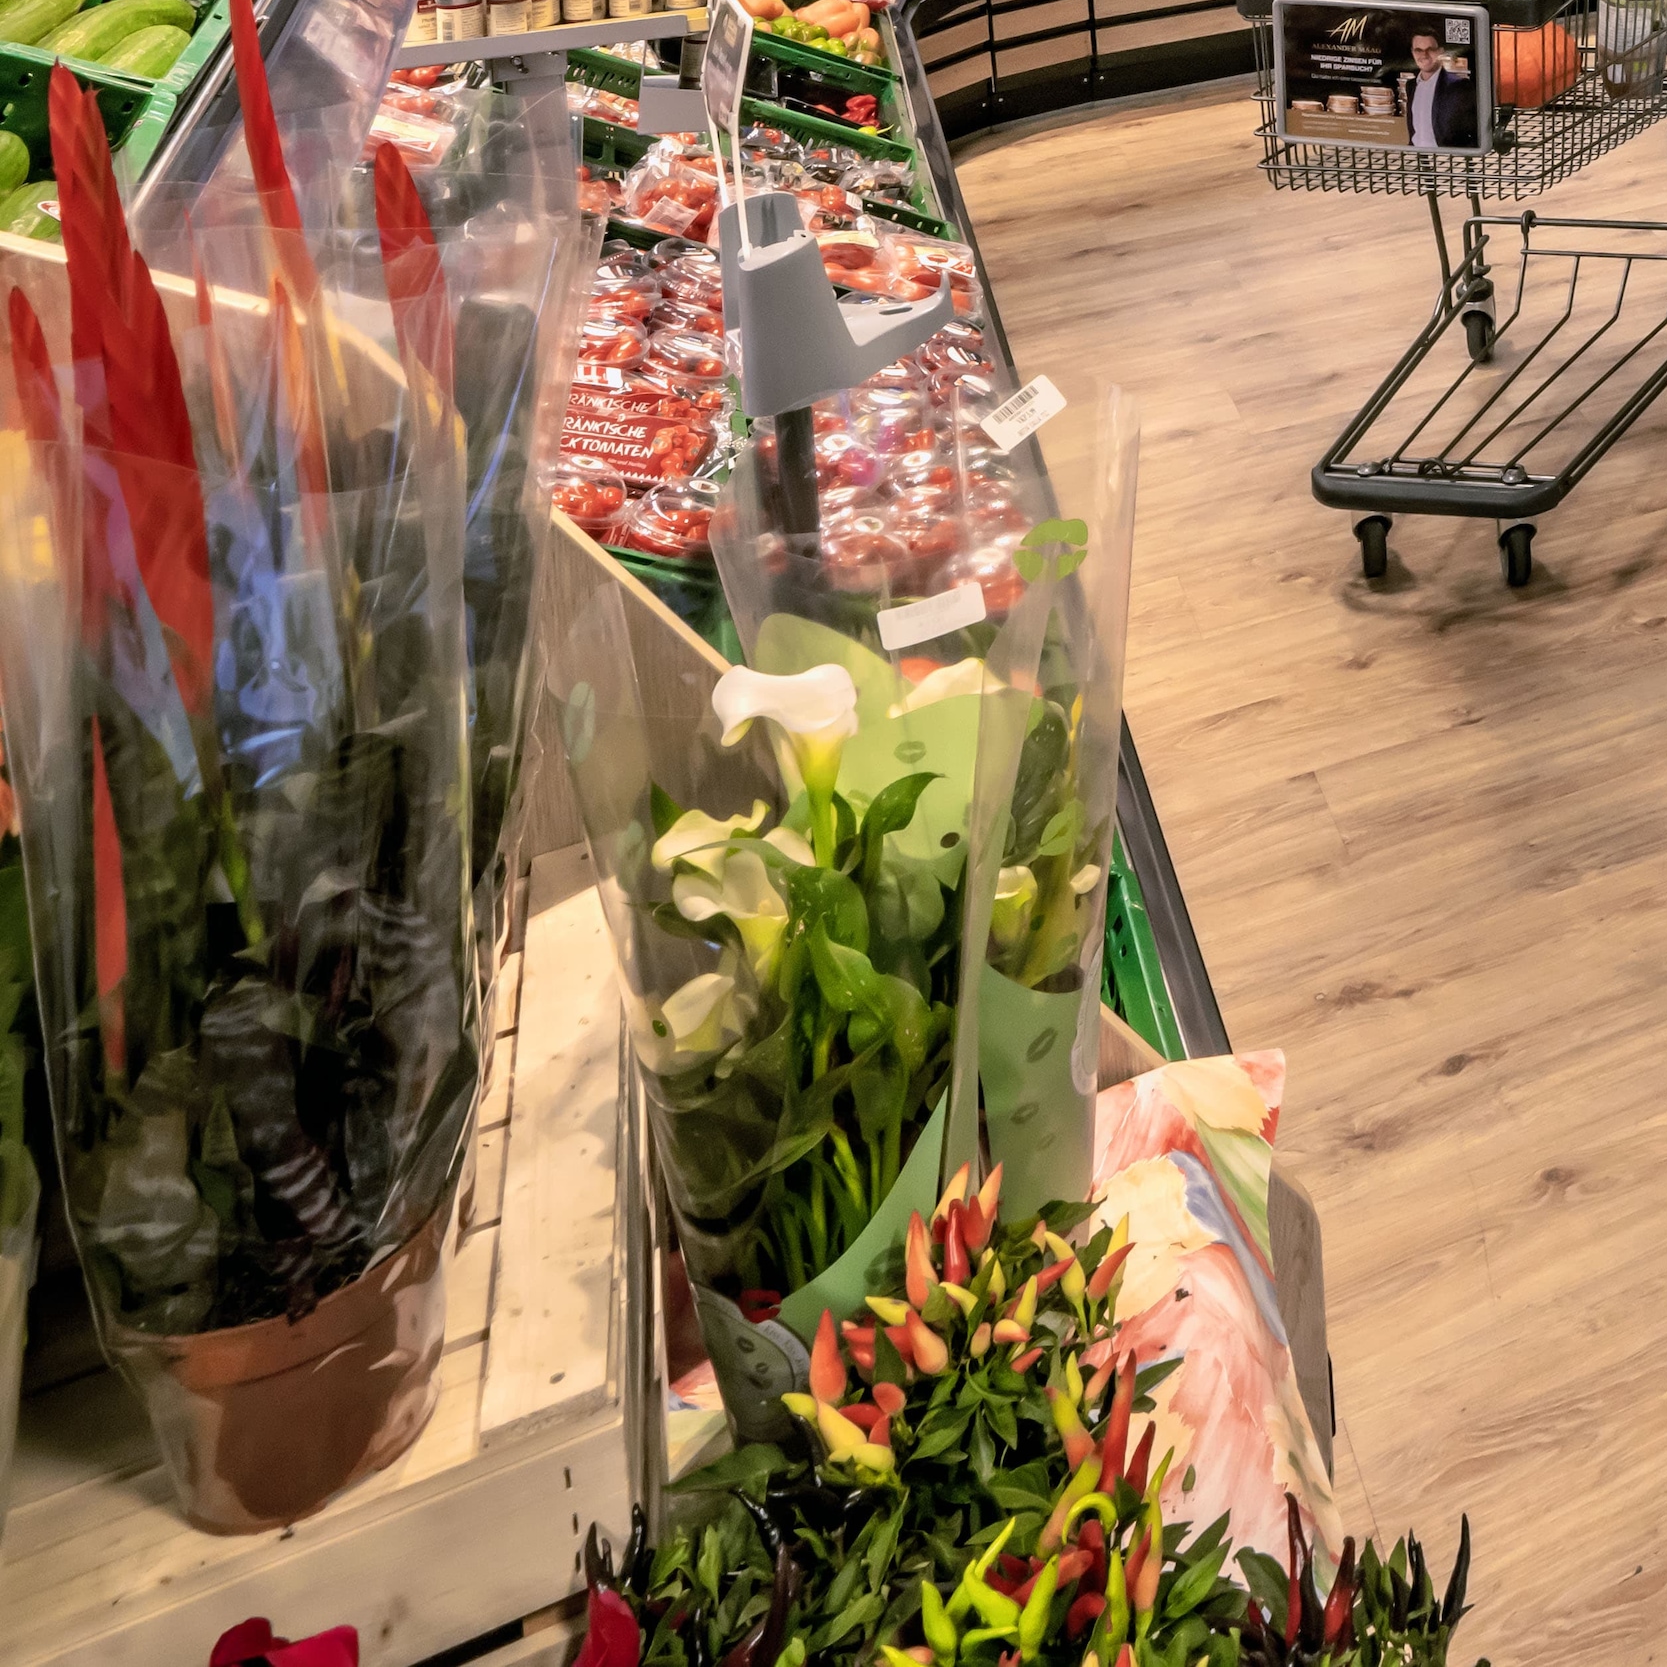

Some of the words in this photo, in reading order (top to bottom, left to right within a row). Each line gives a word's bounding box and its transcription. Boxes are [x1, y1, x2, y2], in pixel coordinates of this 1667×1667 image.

[1325, 15, 1368, 44] AM
[1312, 43, 1357, 52] ALEXANDER
[1311, 54, 1342, 63] NIEDRIGE
[1343, 57, 1367, 65] ZINSEN
[1368, 58, 1383, 66] FÜR
[1333, 63, 1373, 72] SPARBUCH?
[568, 393, 651, 414] RÄNKISCHE
[562, 416, 648, 439] RÄNKISCHE
[560, 435, 654, 460] CKTOMATEN
